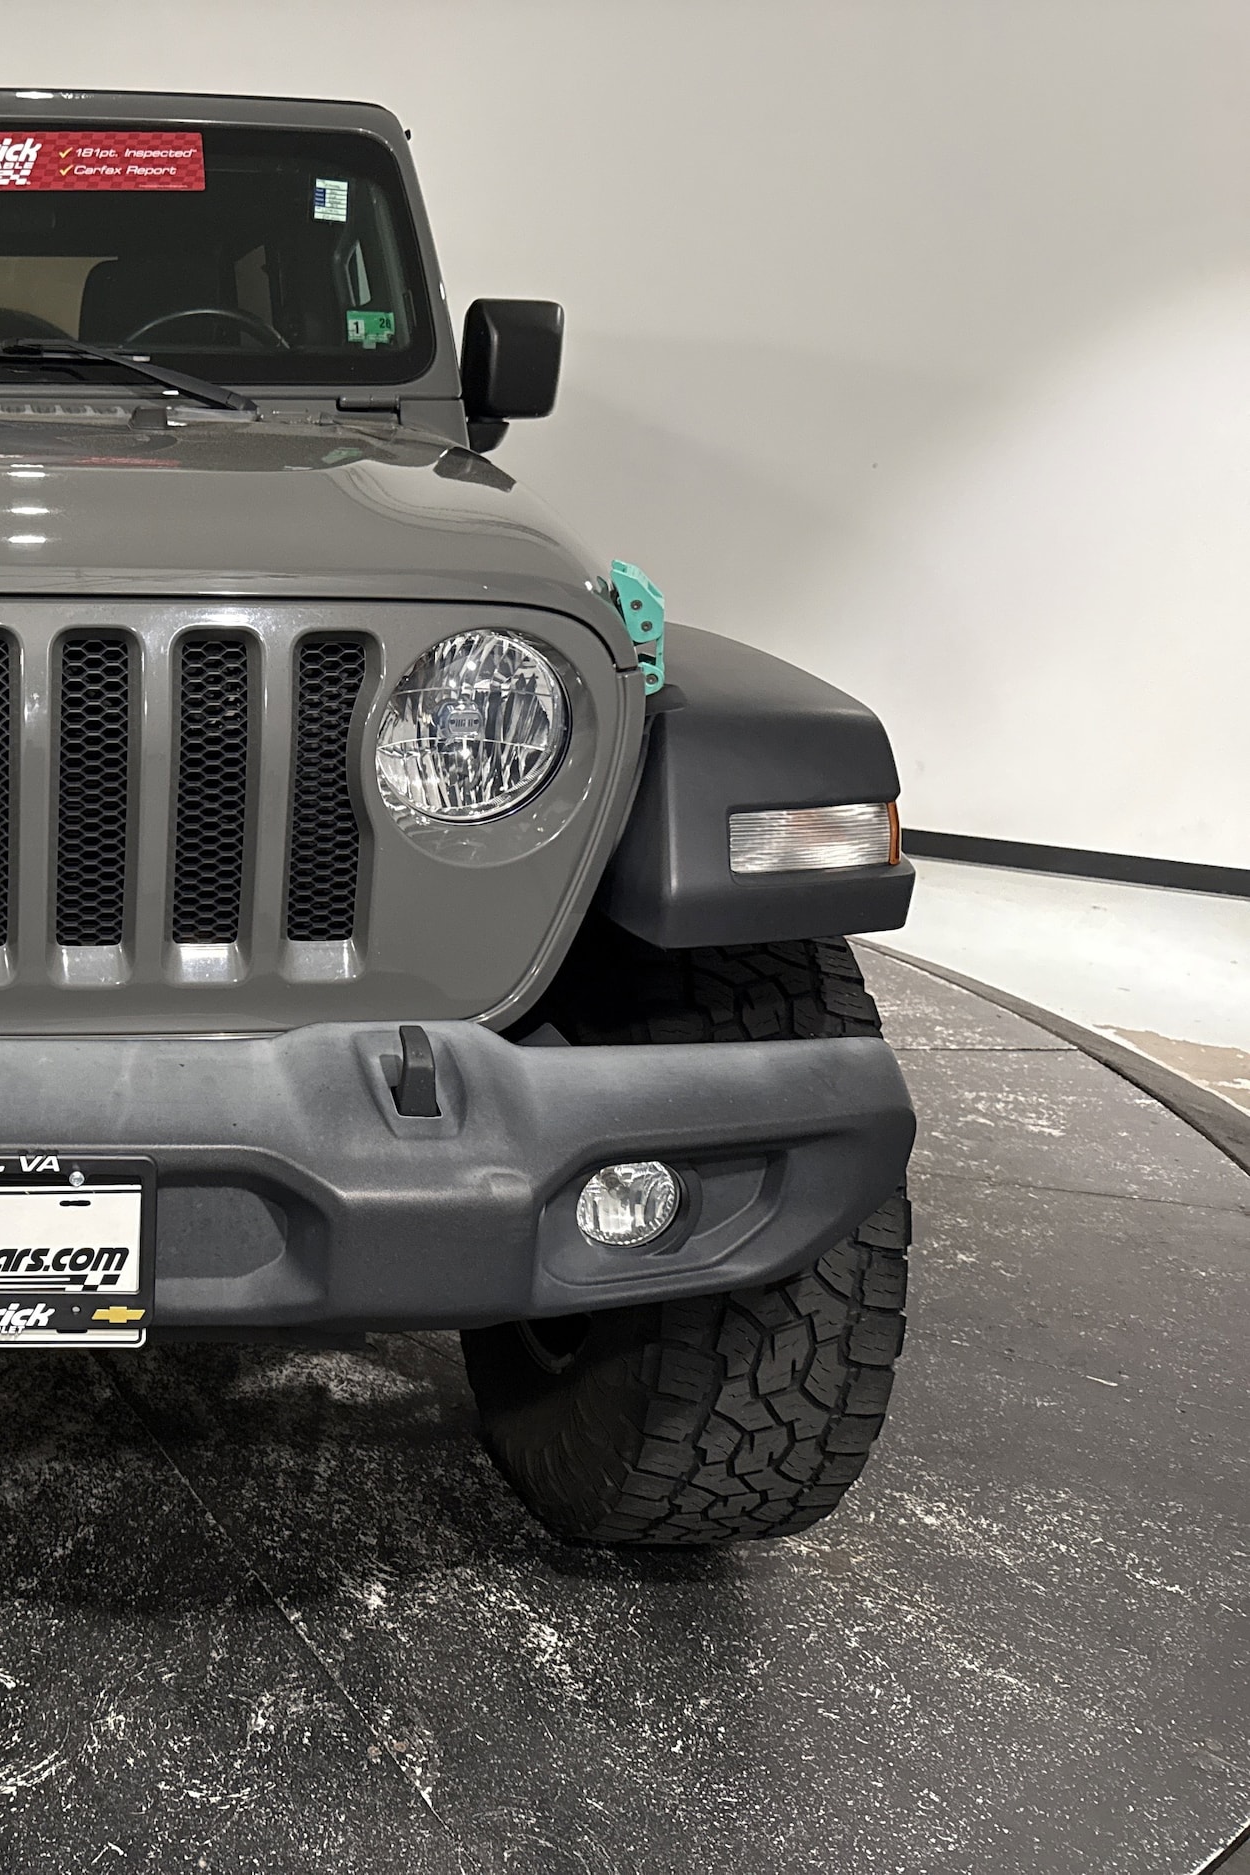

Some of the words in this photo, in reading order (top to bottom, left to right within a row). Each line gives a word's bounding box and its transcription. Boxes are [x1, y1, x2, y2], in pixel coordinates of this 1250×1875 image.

[75, 148, 118, 160] 181pt.
[74, 165, 122, 175] Carfax
[126, 165, 177, 176] Report
[353, 321, 359, 334] 1
[19, 1155, 60, 1172] VA
